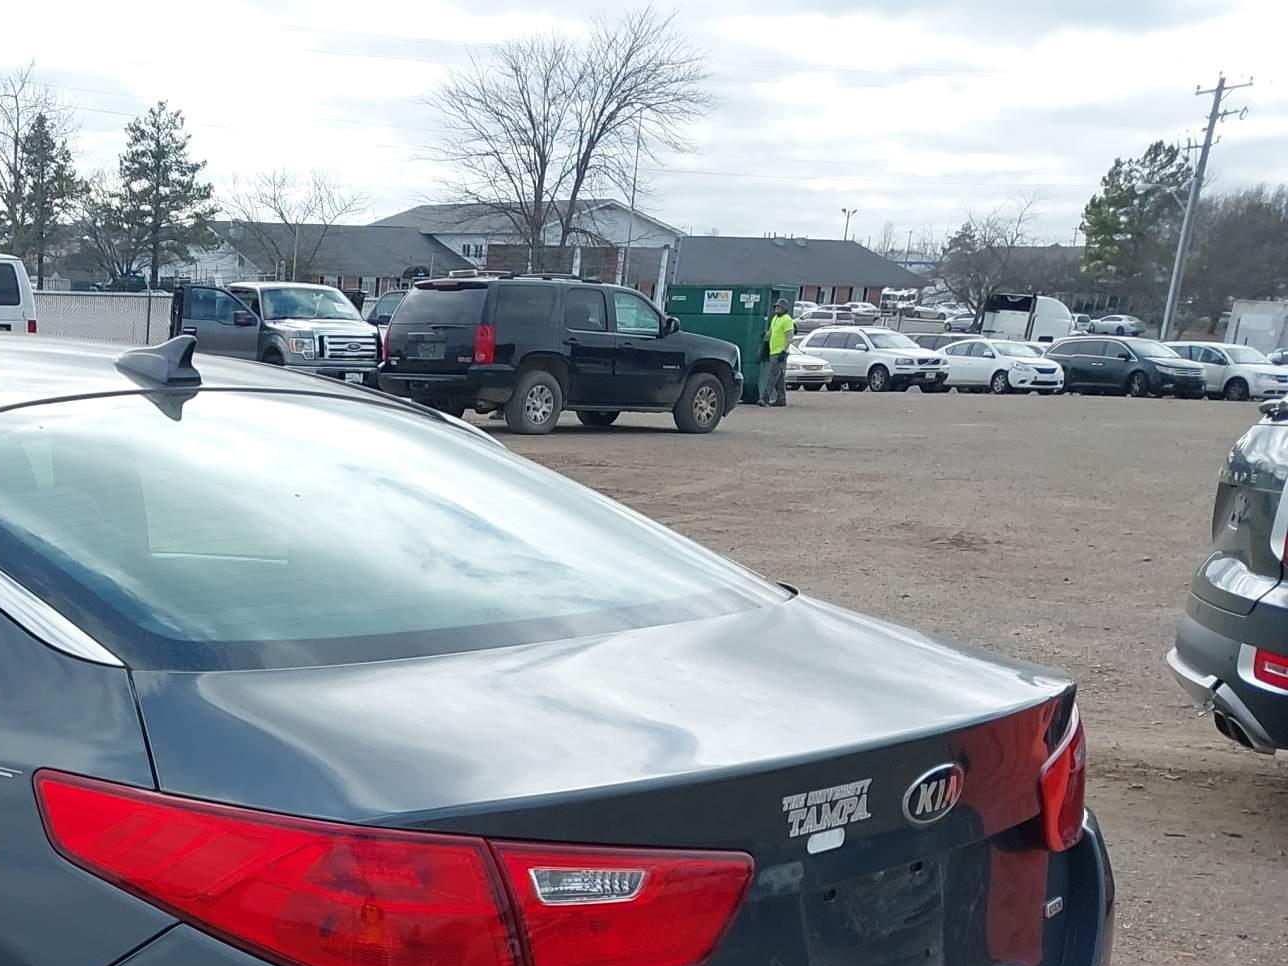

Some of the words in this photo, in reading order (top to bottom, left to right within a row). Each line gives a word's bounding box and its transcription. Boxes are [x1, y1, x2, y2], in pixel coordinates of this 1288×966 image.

[782, 793, 808, 812] THE
[807, 778, 873, 806] UNIVERSITY
[915, 775, 959, 816] KIA
[788, 794, 872, 838] TAMPA
